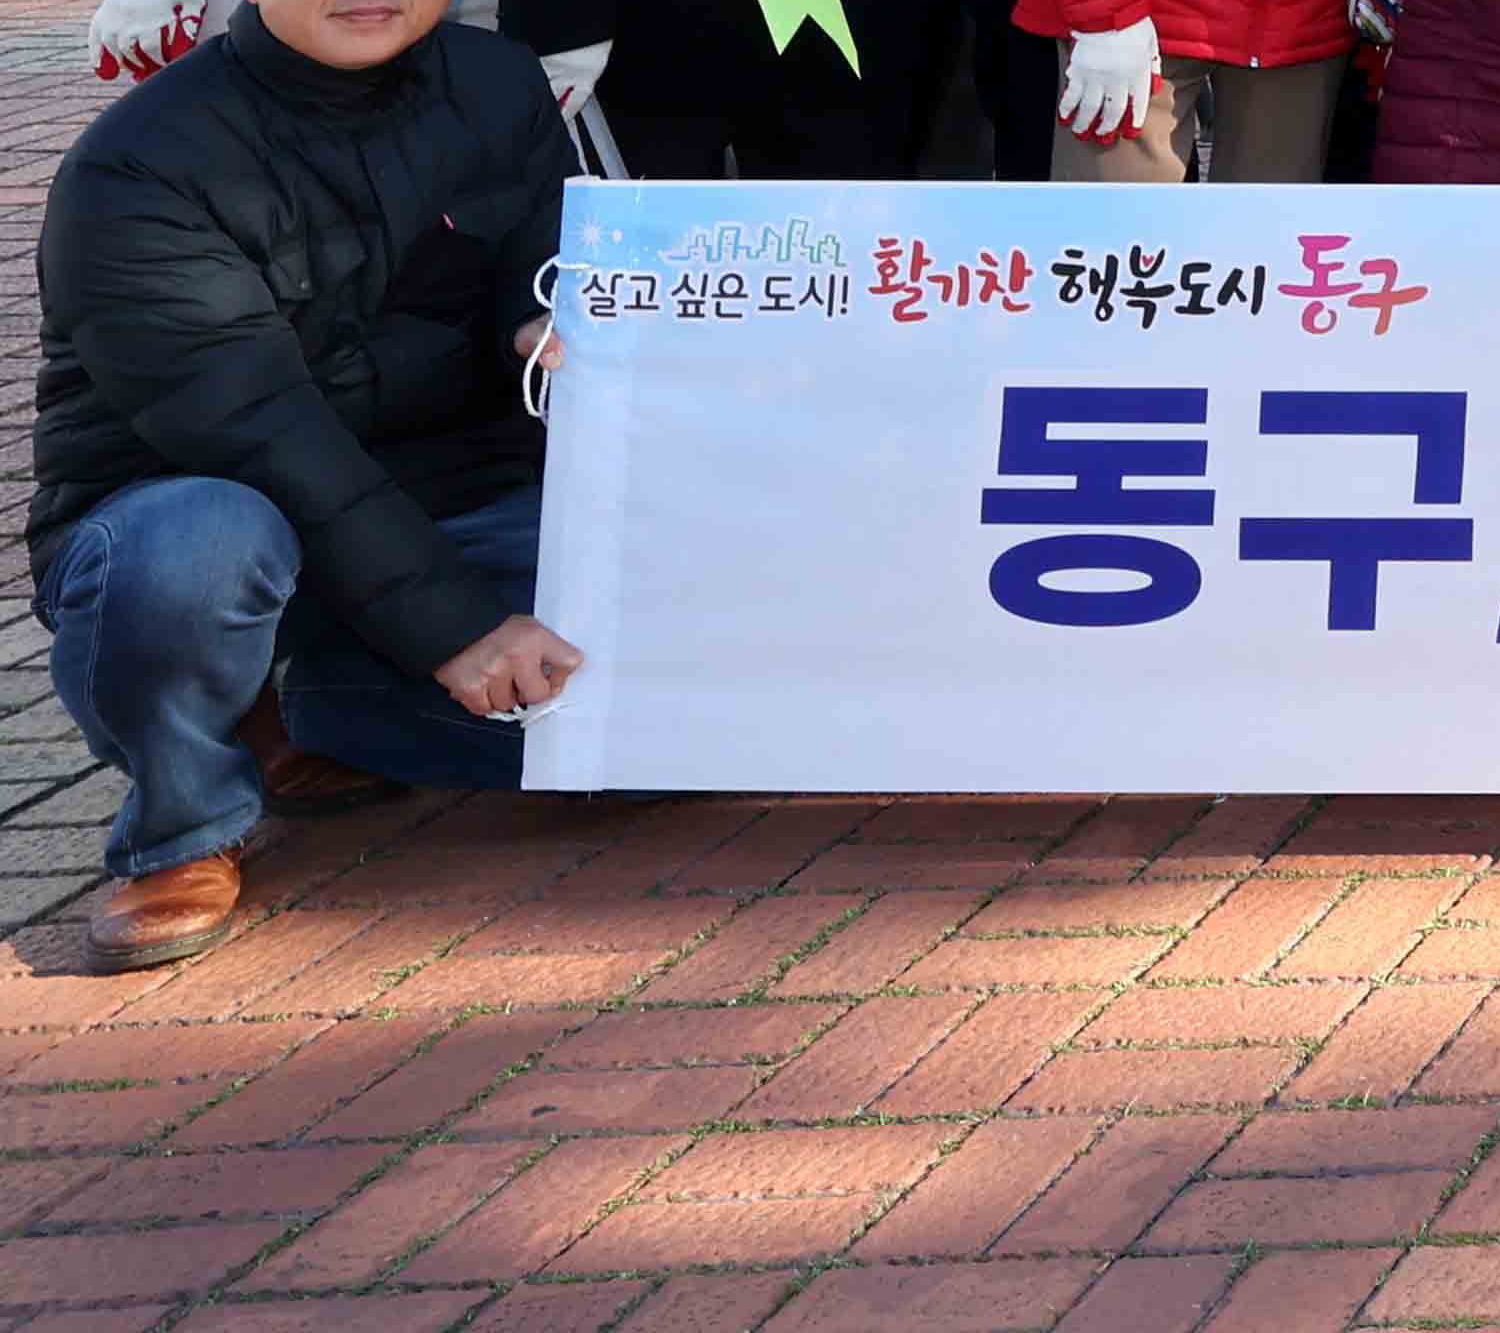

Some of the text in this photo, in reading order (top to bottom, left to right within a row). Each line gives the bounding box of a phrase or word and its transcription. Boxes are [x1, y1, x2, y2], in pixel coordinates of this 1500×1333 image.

[582, 271, 850, 319] 살고 싶은 도시!
[866, 234, 1429, 335] 활기찬 행복도시 동구
